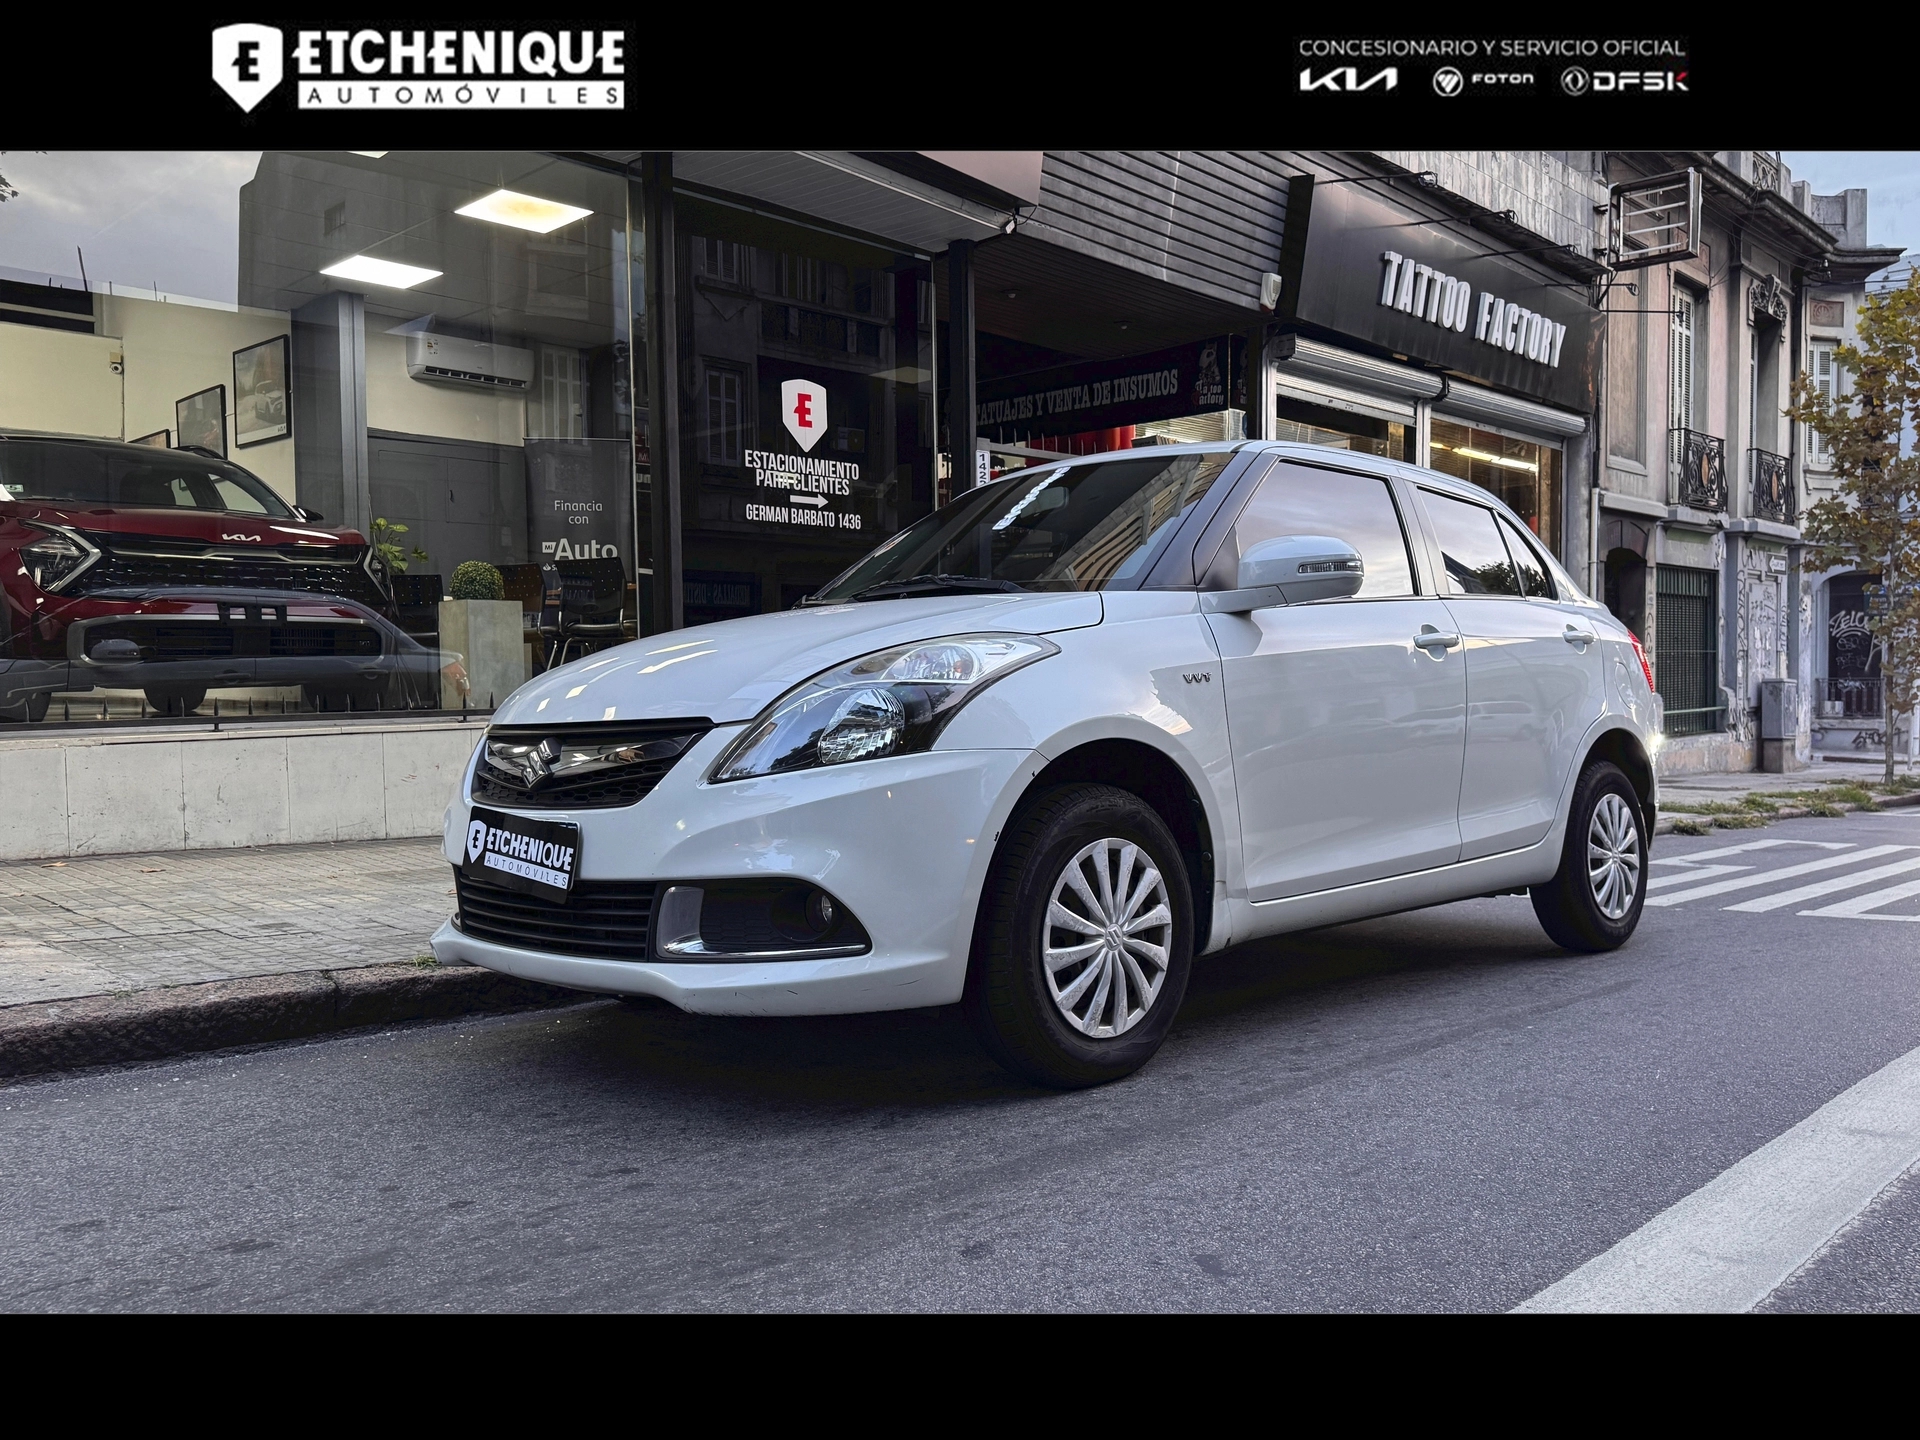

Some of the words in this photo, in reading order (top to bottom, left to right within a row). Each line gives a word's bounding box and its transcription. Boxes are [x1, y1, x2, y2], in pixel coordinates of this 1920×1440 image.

[1381, 250, 1471, 333] TATTOO
[1475, 291, 1567, 369] FACTORY
[1035, 392, 1044, 416] Y
[1046, 385, 1090, 414] VENTA
[1093, 380, 1111, 404] DE
[1113, 369, 1179, 402] INSUMOS
[744, 449, 860, 481] ESTACIONAMIENTO
[755, 469, 791, 490] PARA
[793, 473, 850, 496] CLIENTES
[554, 500, 603, 512] Financia
[745, 503, 789, 524] GERMAN
[791, 508, 835, 527] BARBATO
[838, 513, 862, 530] 1436
[568, 515, 589, 525] con
[554, 537, 618, 561] Auto
[1182, 672, 1212, 684] VVT
[486, 827, 574, 872] ETCHENIQUE
[486, 857, 567, 887] AUTOMÓVILES
